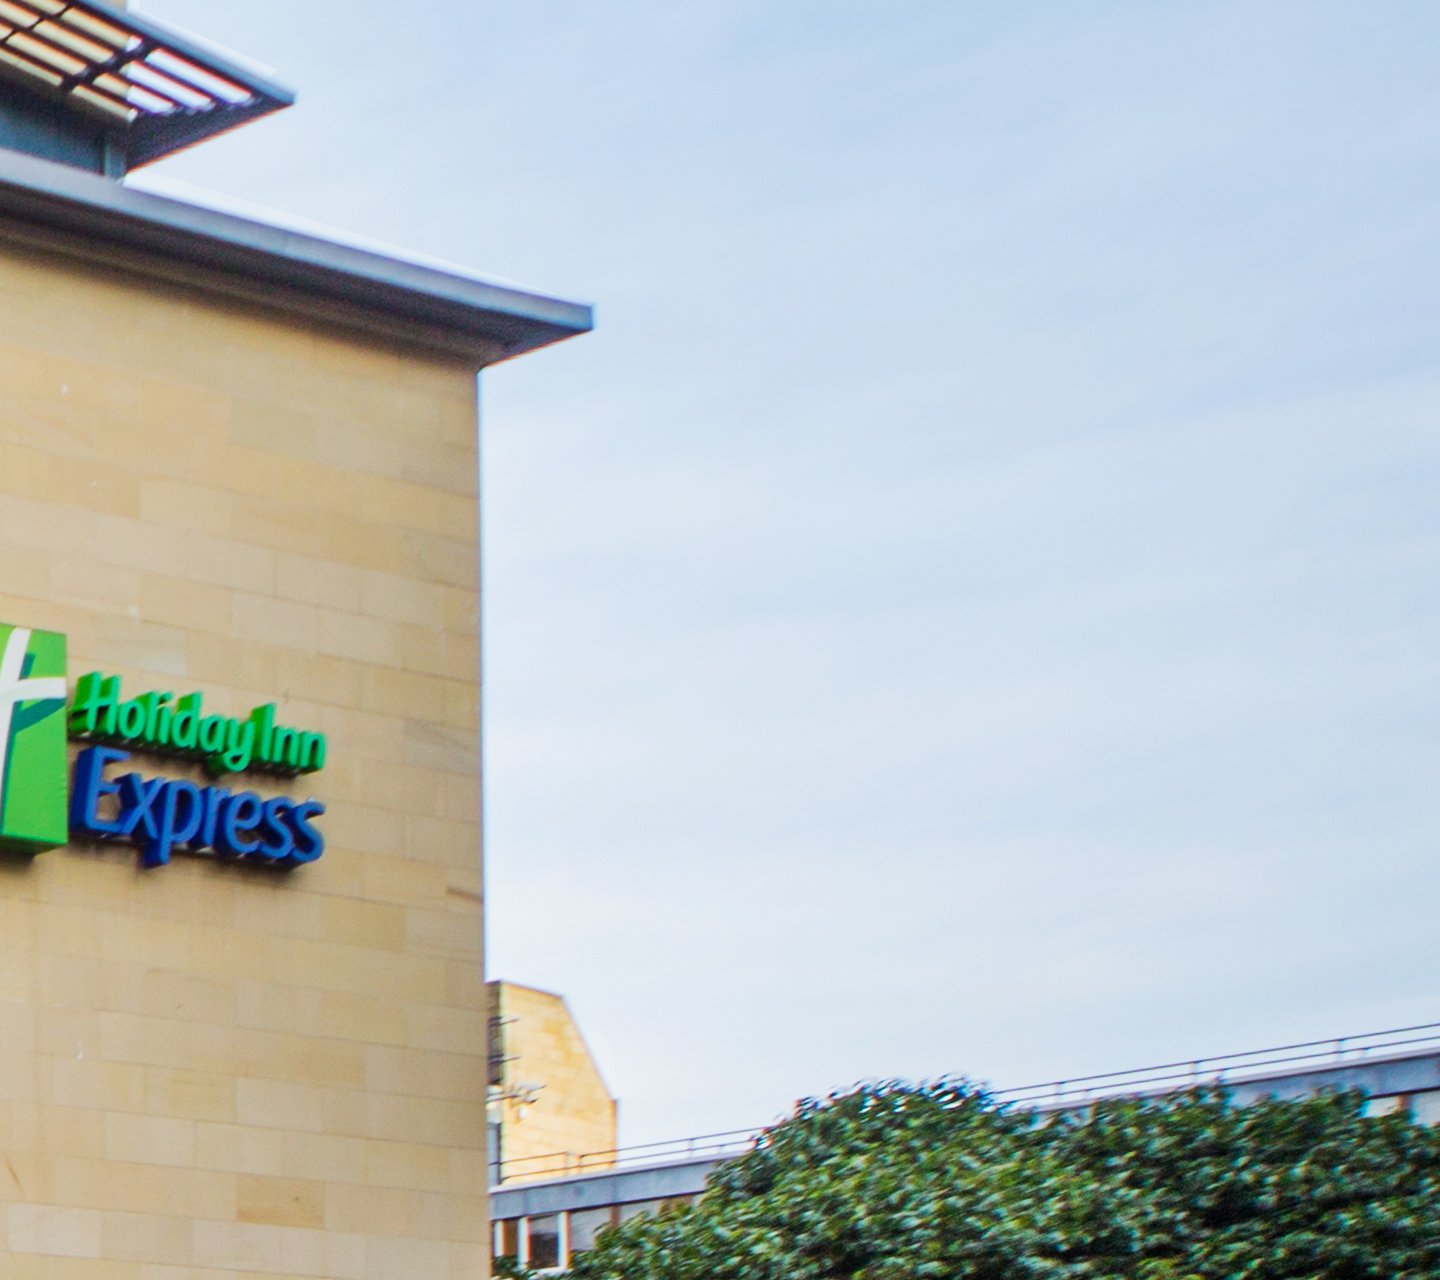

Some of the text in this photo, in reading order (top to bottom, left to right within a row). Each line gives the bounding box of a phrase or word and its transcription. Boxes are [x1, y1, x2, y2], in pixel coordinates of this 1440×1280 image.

[69, 670, 327, 773] Holiday Inn
[69, 745, 327, 867] Express
